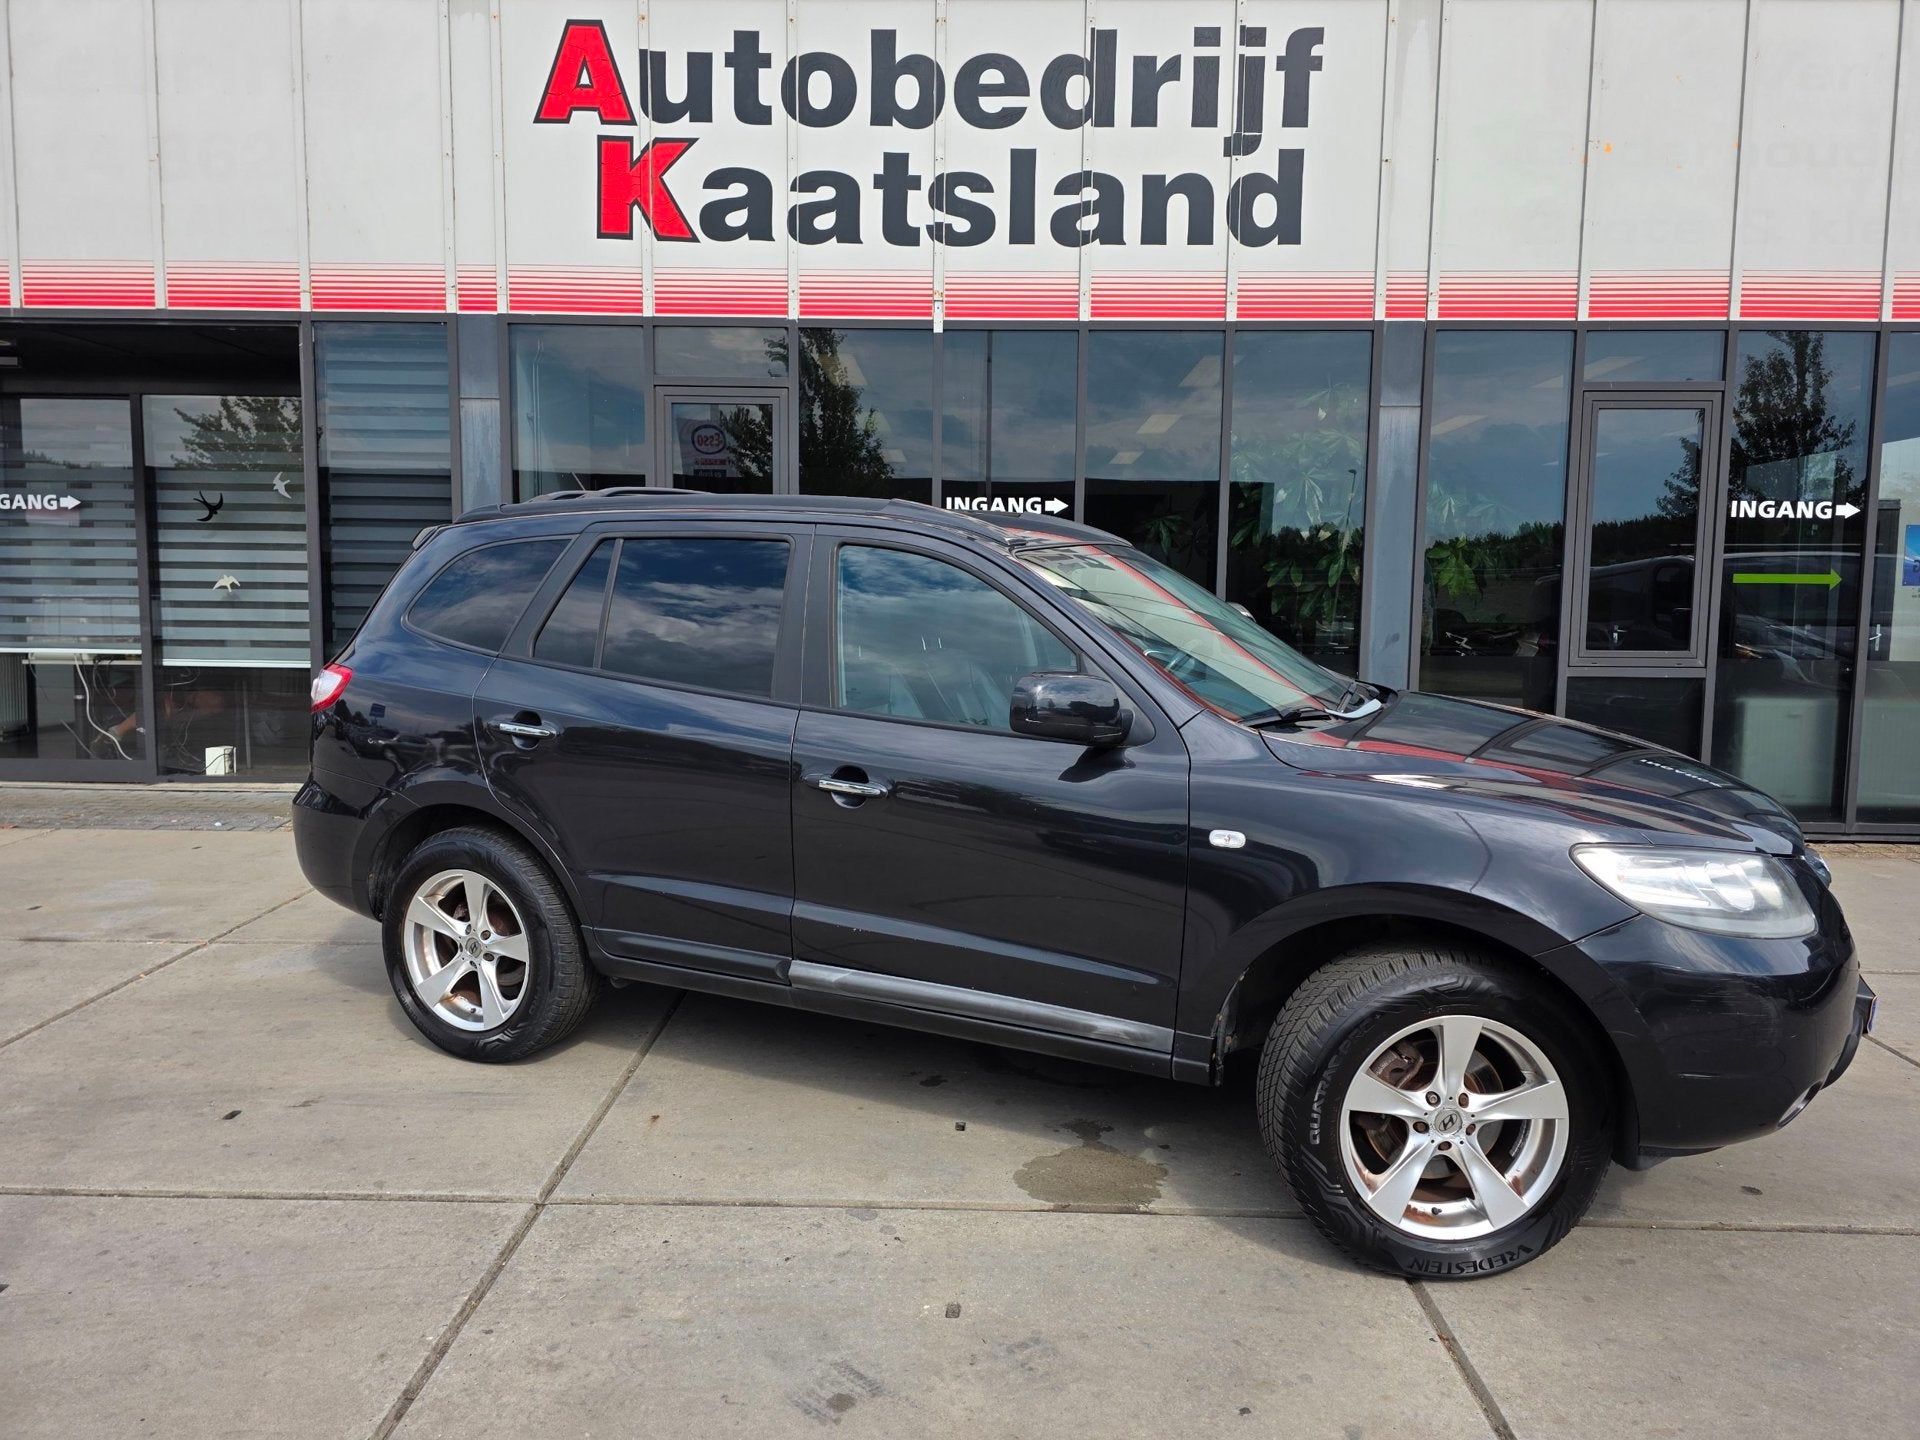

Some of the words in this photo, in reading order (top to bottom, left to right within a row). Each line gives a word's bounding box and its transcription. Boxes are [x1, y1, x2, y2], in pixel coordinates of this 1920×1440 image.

[534, 19, 1325, 157] Autobedrijf
[596, 136, 1305, 247] Kaatsland
[0, 493, 58, 510] GANG
[946, 497, 1042, 514] INGANG
[1730, 500, 1833, 519] INGANG
[1408, 1244, 1534, 1275] VREDESTEIN
